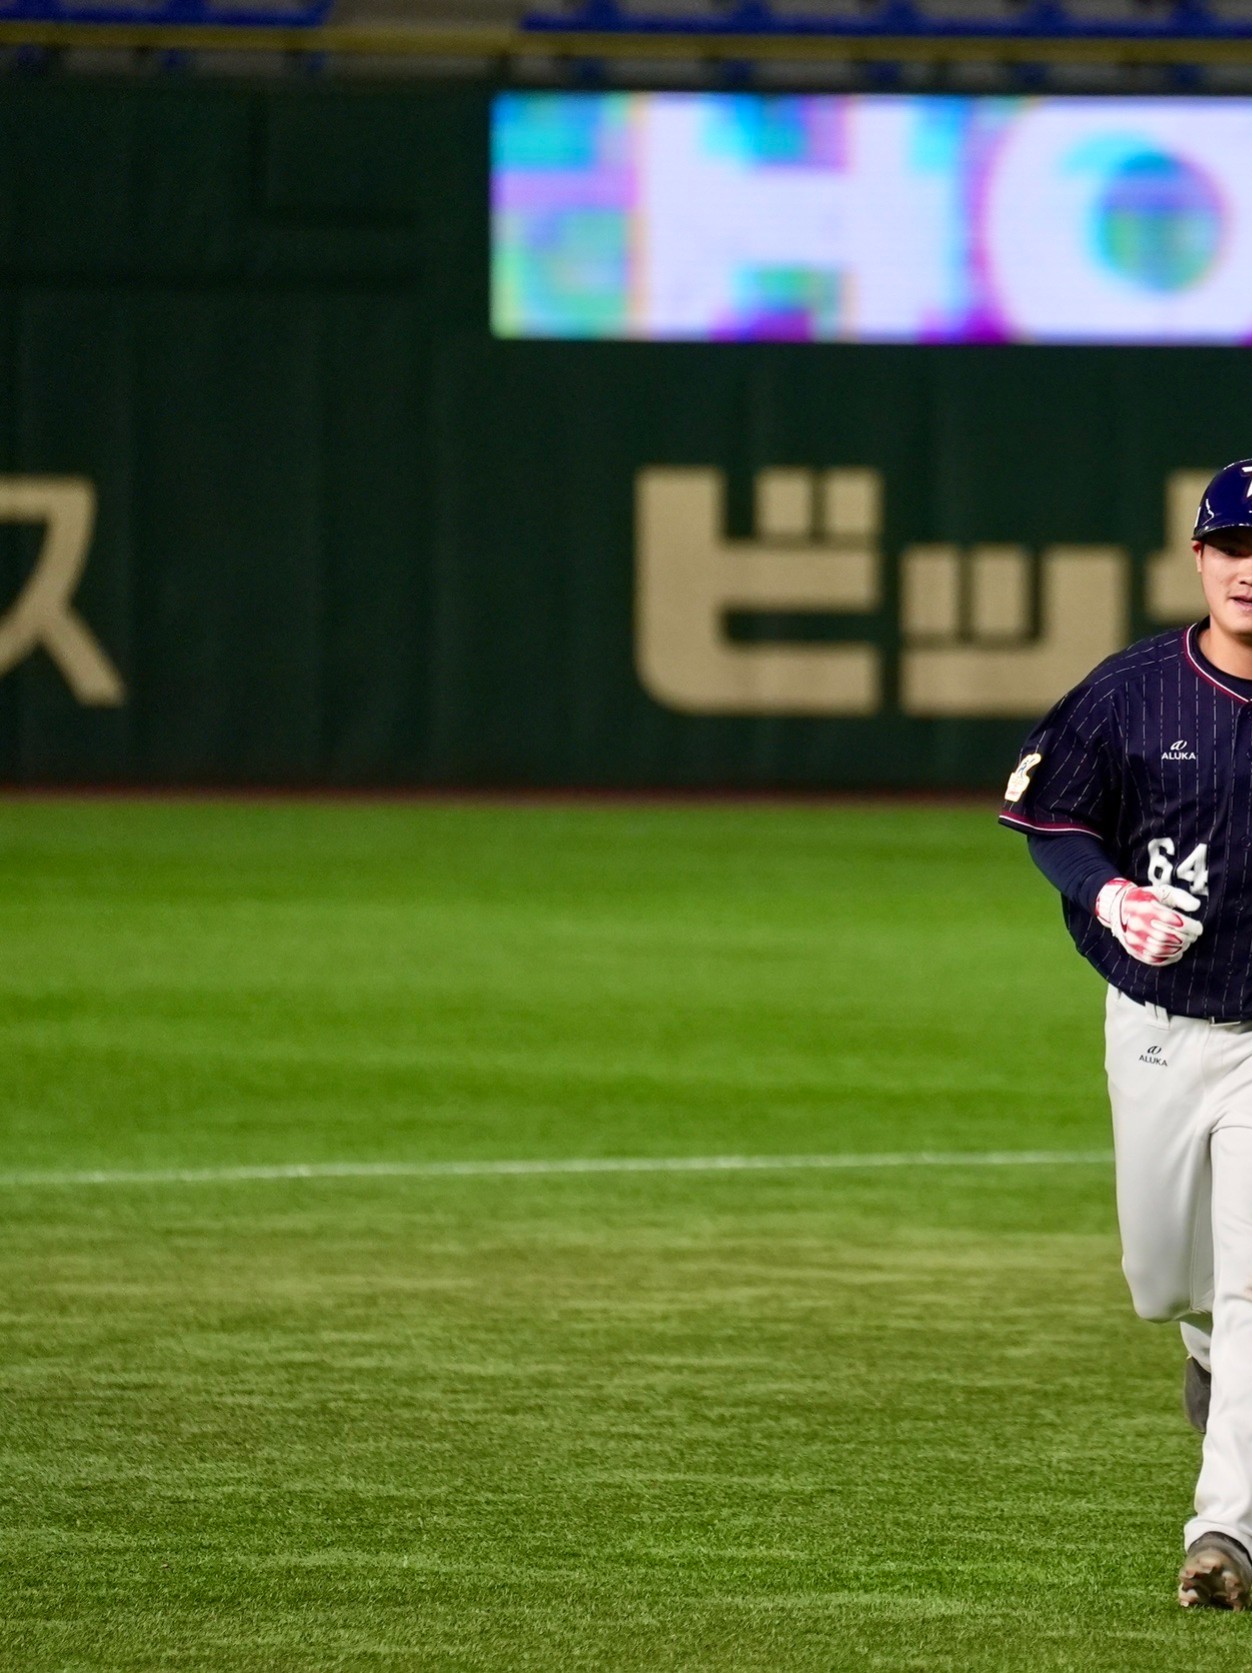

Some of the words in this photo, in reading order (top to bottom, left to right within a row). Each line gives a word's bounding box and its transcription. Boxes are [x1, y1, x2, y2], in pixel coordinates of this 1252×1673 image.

[1161, 752, 1196, 760] ALUKA
[1147, 837, 1210, 896] 64
[1138, 1054, 1168, 1067] ALUKA
